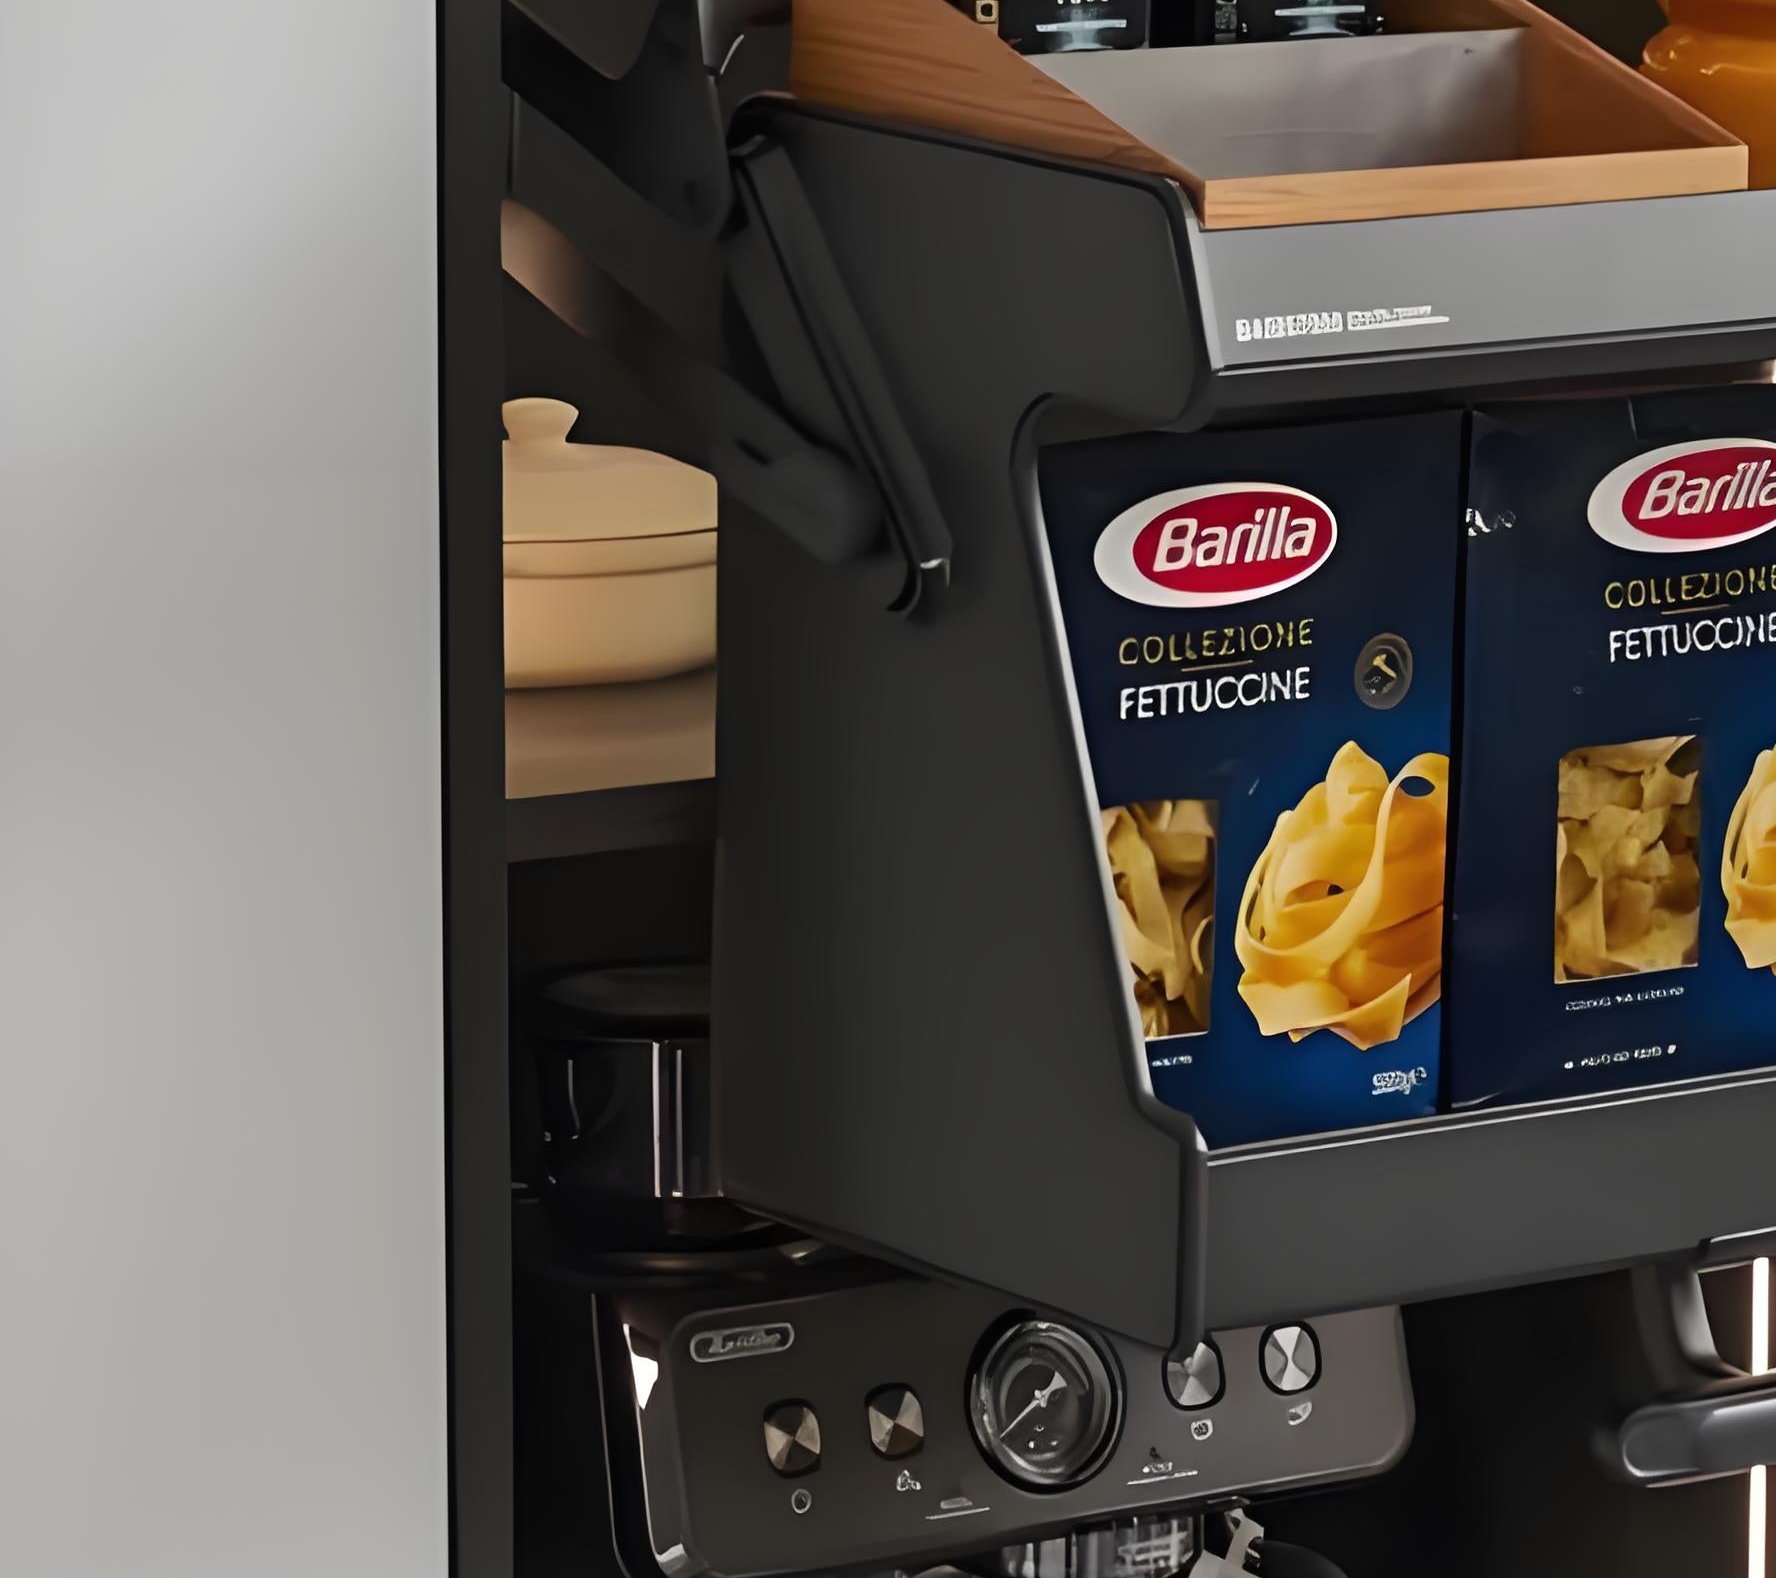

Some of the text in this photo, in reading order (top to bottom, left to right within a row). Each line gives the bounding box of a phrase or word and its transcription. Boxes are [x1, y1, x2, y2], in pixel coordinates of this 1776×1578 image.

[1152, 505, 1317, 572] Barilla
[1118, 618, 1315, 665] COLLEZIONE
[1119, 666, 1311, 720] FETTUCCINE
